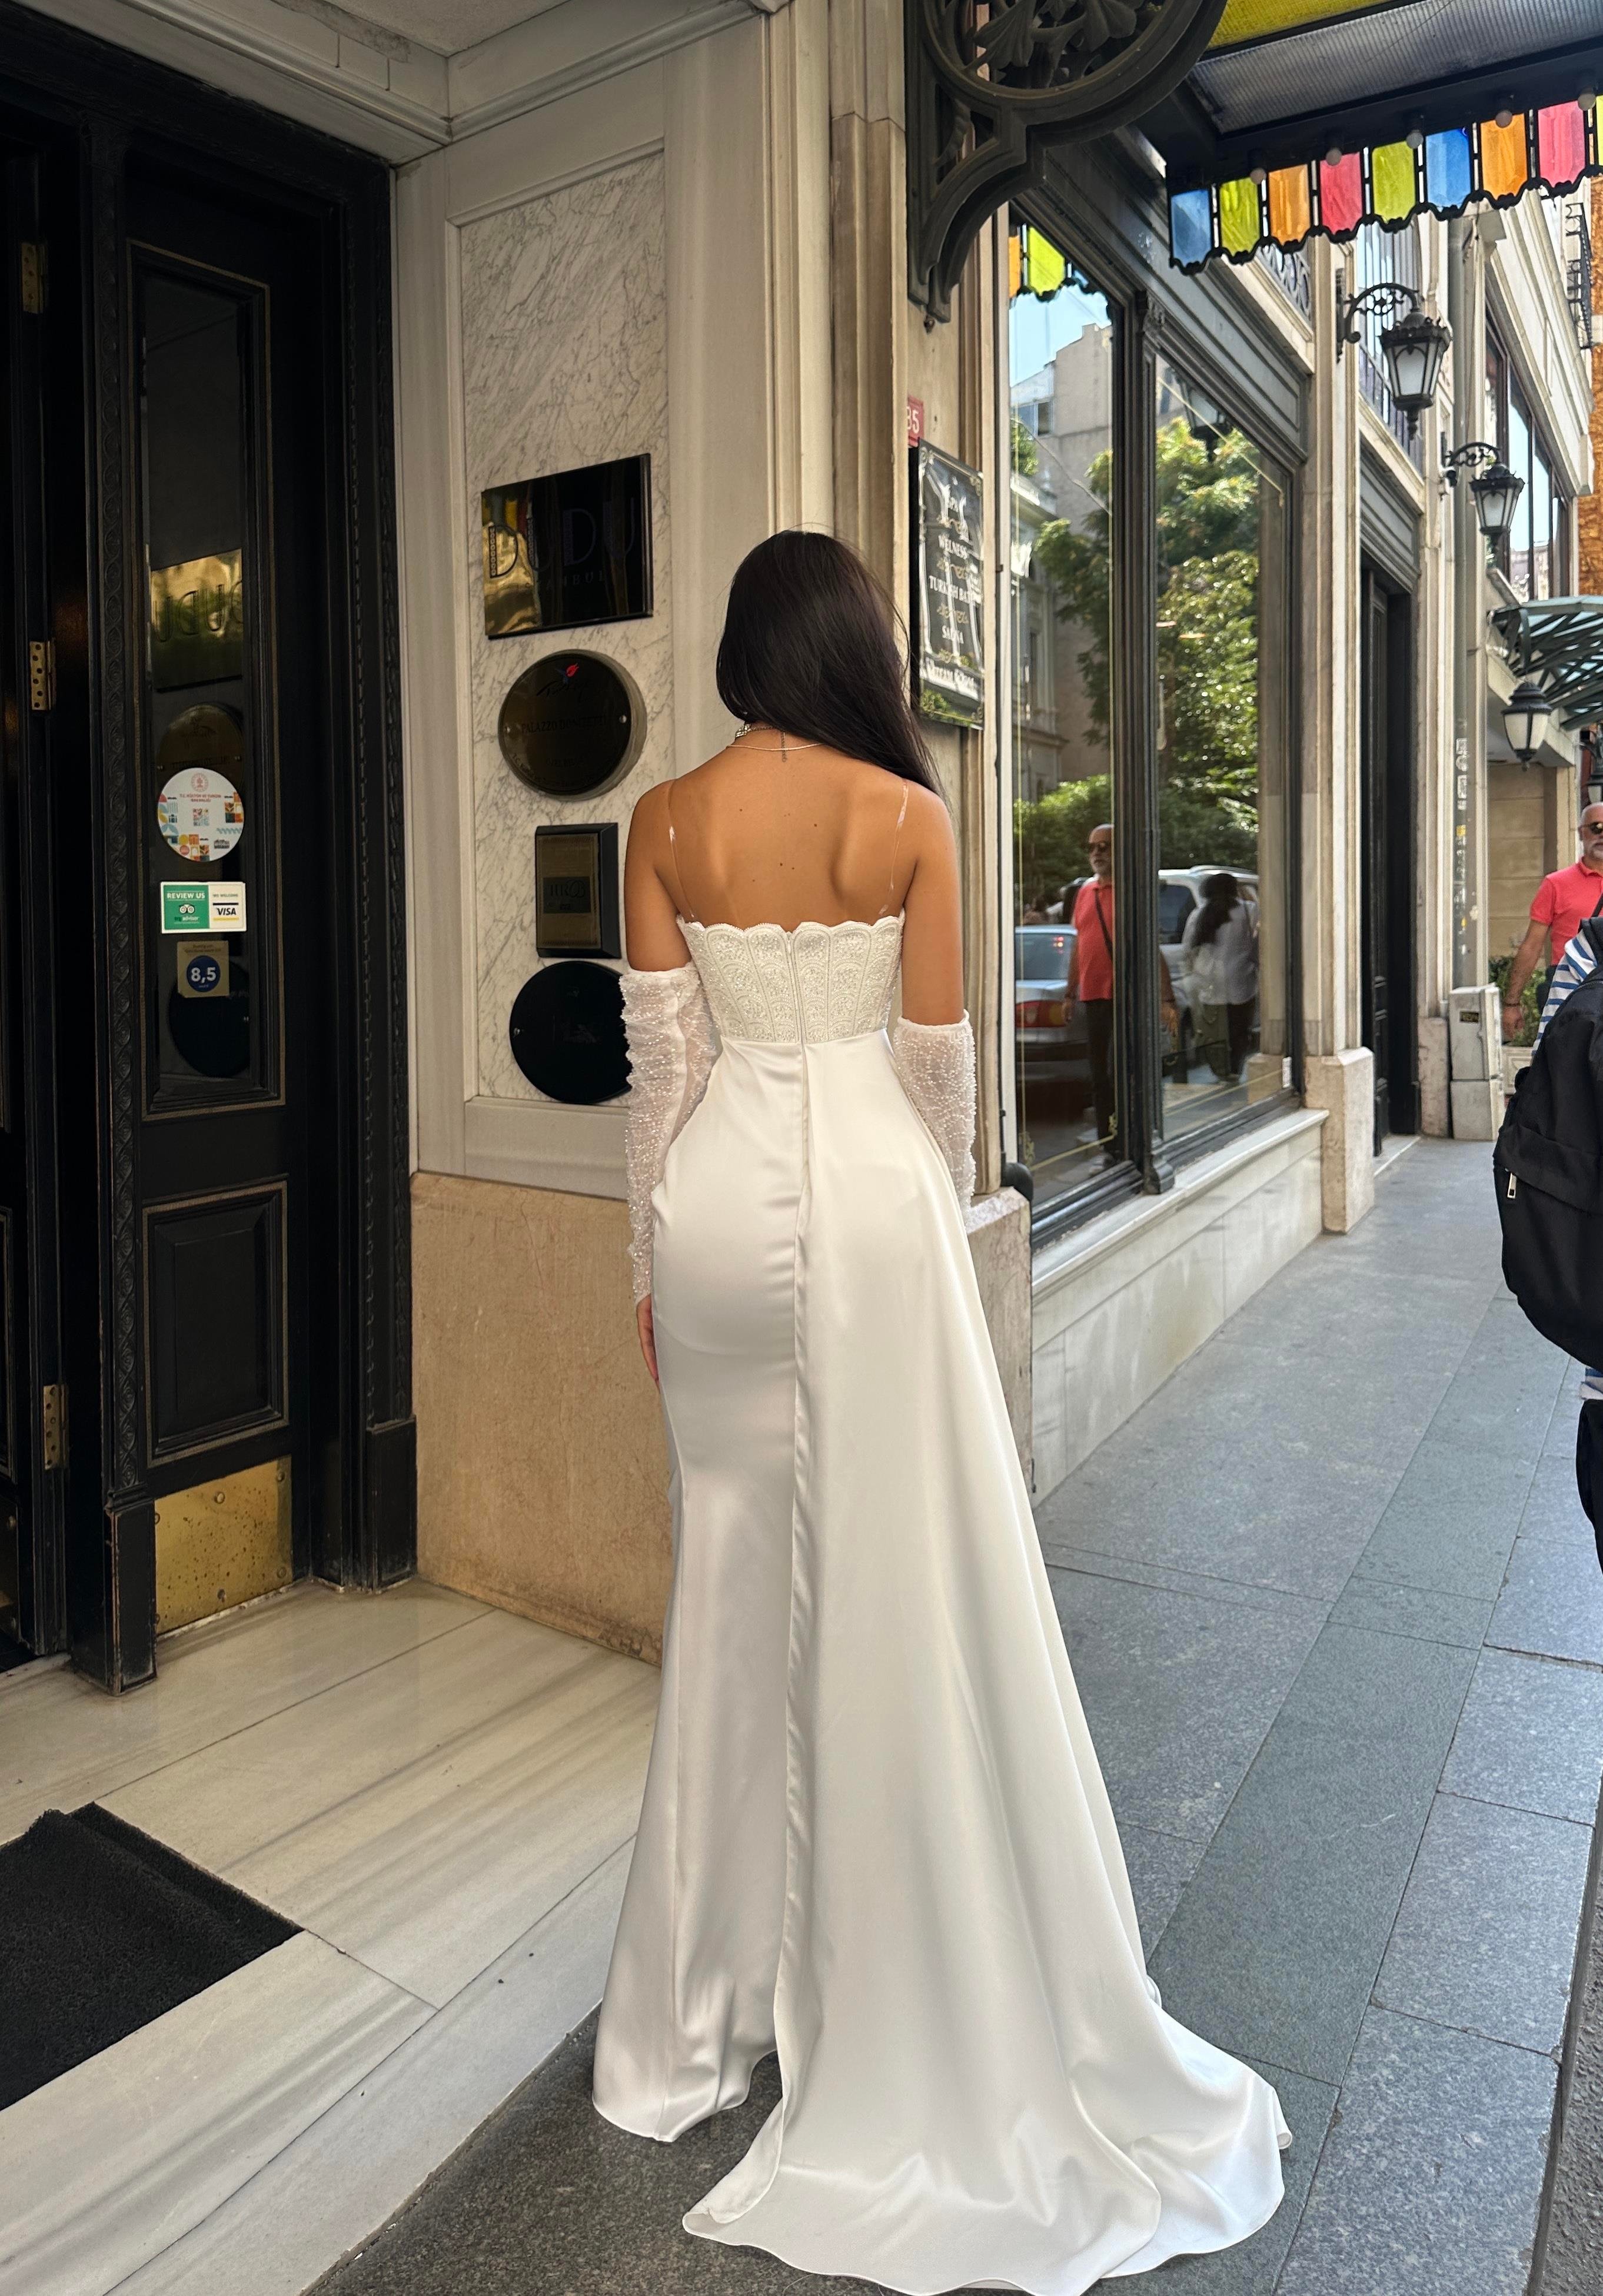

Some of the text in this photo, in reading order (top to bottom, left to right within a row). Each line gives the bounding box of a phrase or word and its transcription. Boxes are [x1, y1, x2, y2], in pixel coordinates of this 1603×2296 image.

[928, 575, 959, 599] TURKSH
[942, 625, 964, 644] SAA
[217, 908, 237, 916] VISA
[191, 967, 217, 984] 8,5
